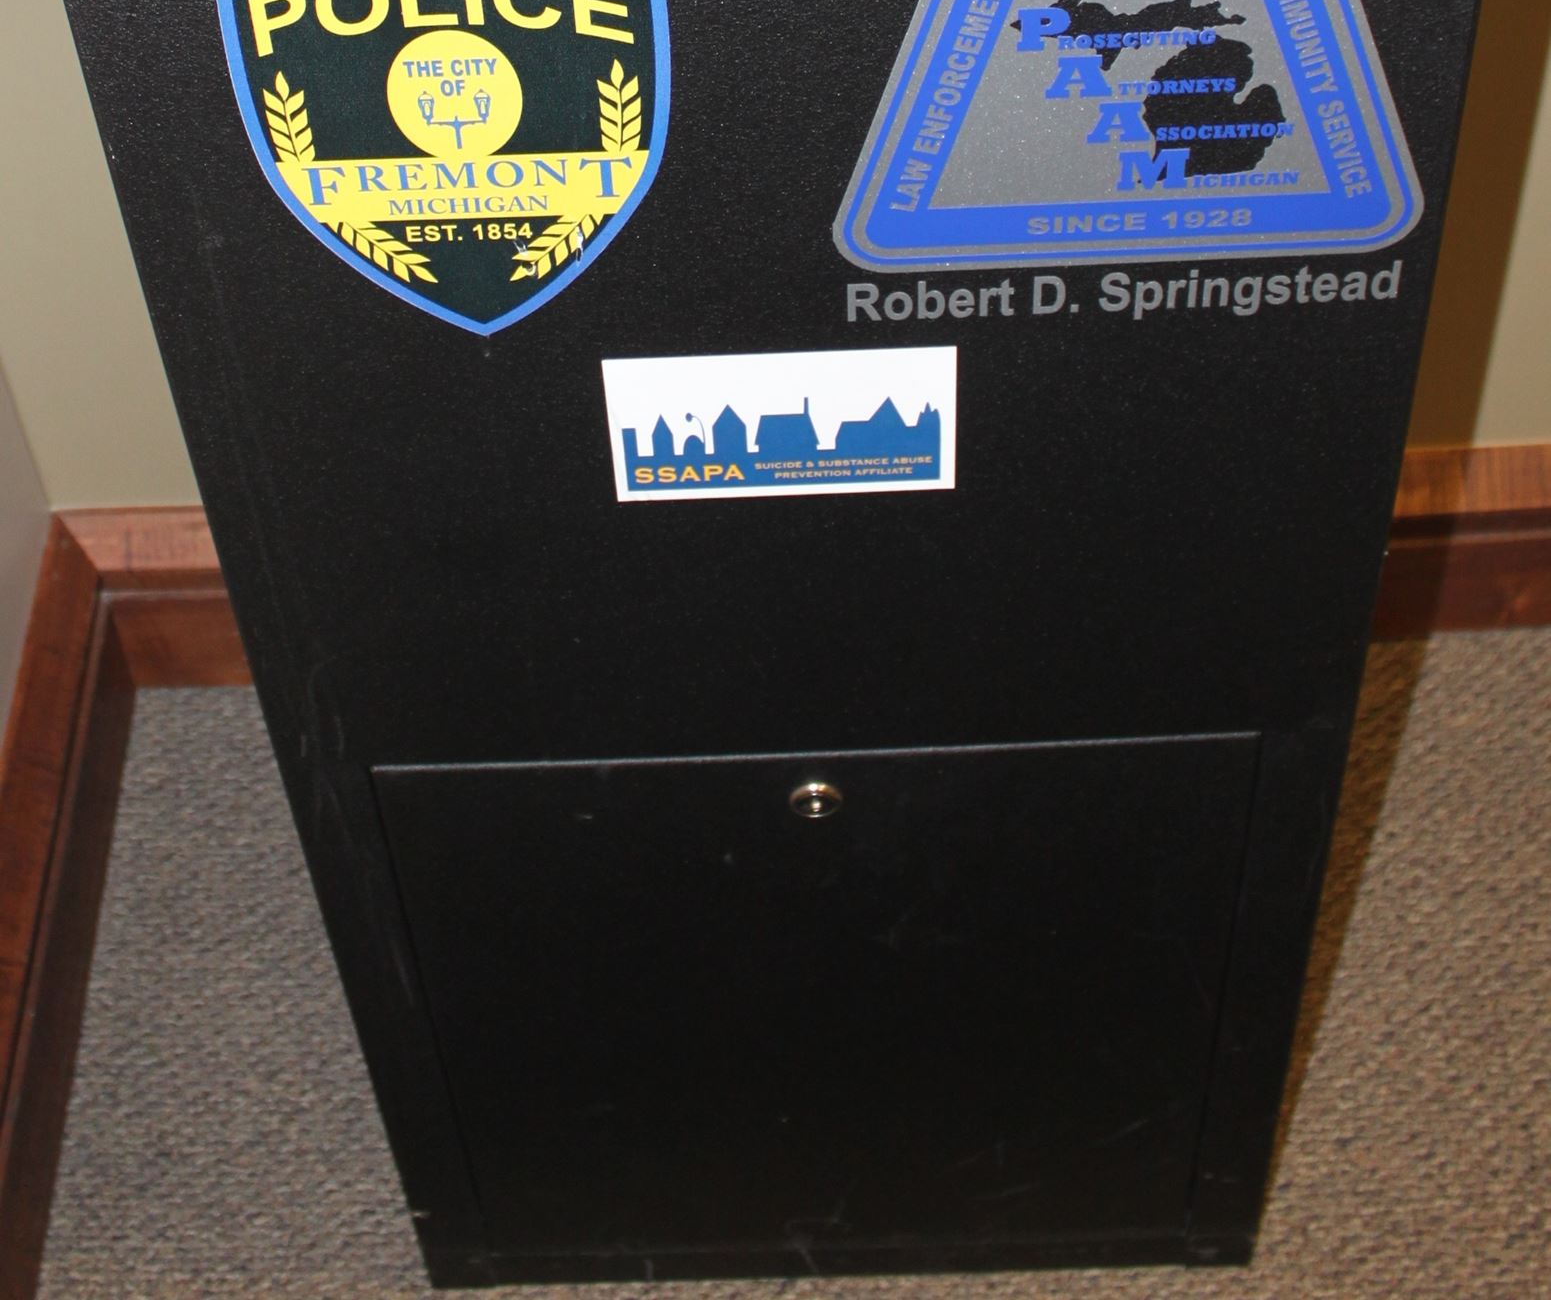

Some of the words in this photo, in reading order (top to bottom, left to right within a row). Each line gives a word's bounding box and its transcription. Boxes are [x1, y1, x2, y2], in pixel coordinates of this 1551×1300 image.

[402, 60, 443, 78] THE
[450, 58, 497, 77] CITY
[440, 80, 465, 97] OF
[1318, 98, 1372, 198] SERVICE
[301, 156, 633, 206] FREMONT
[890, 156, 932, 212] LAW
[388, 194, 548, 216] MICHIGAN
[405, 225, 463, 242] EST.
[472, 222, 532, 240] 1854
[1027, 212, 1147, 236] SINCE
[1160, 208, 1253, 230] 1928
[846, 282, 1014, 322] Robert
[1033, 275, 1080, 316] D.
[1098, 261, 1403, 319] Springstead
[755, 461, 802, 470] SUICIDE
[806, 460, 814, 468] &
[818, 457, 889, 467] SUBSTANCE
[892, 456, 933, 464] ABUSE
[774, 469, 851, 479] PREVENTION
[854, 467, 912, 476] AFFILIATE
[634, 464, 745, 484] SSAPA
